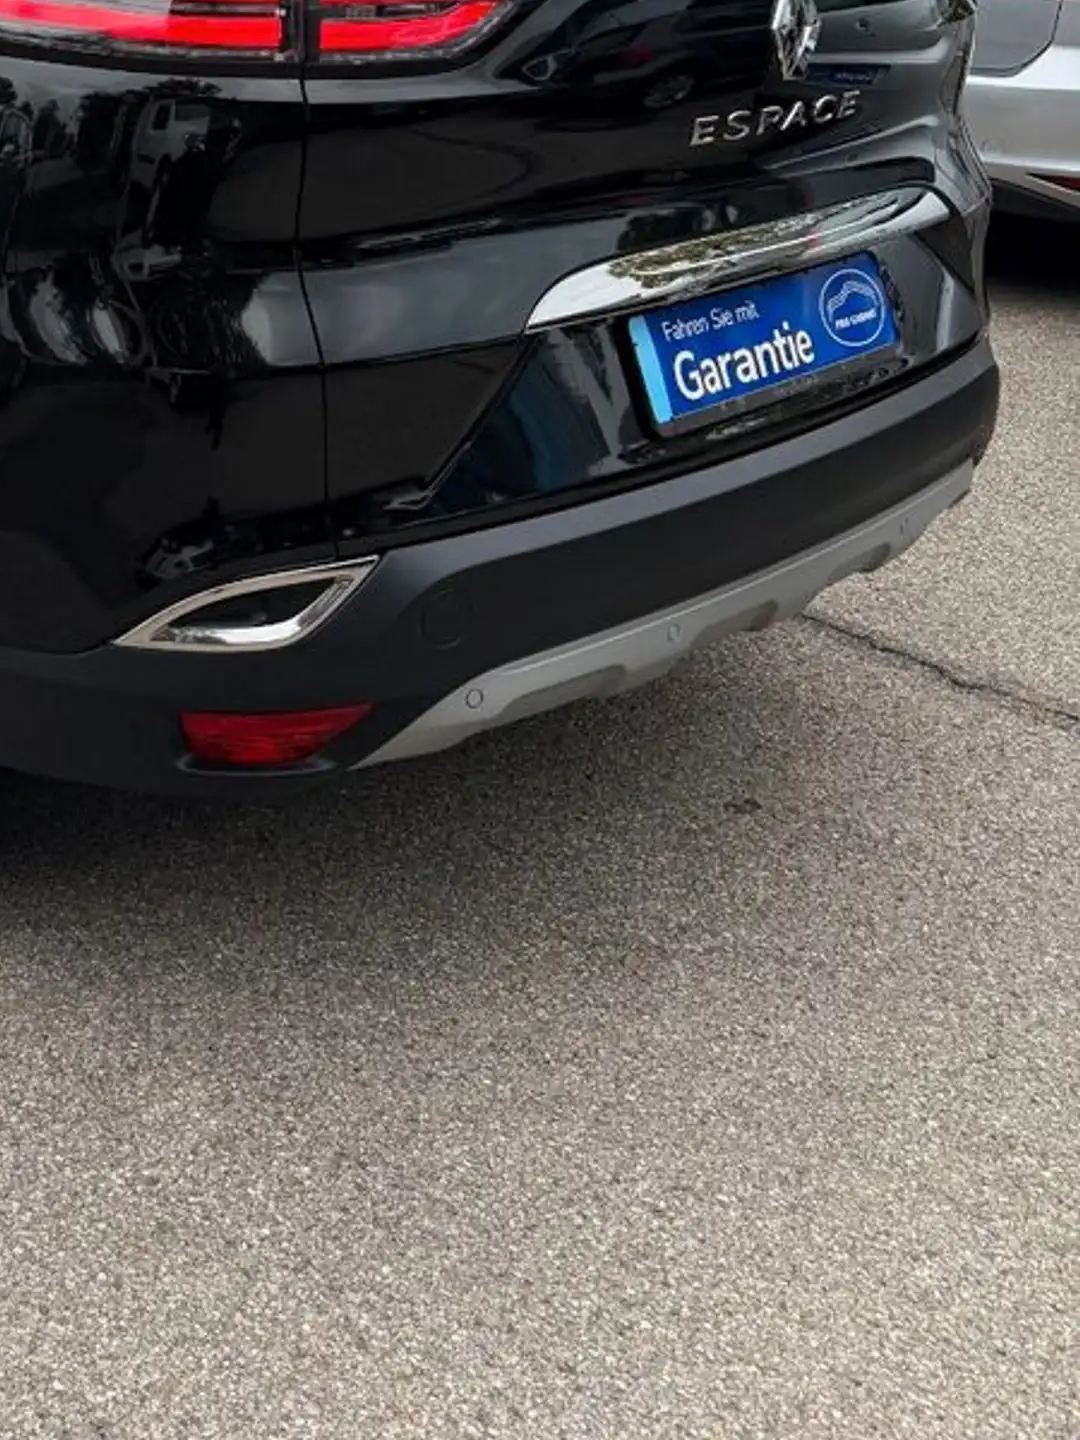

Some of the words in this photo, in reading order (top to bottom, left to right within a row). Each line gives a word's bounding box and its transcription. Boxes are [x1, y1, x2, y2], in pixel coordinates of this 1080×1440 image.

[689, 89, 861, 147] ESPACE
[661, 317, 709, 341] Fahren
[710, 308, 734, 329] Sie
[735, 301, 760, 323] mit
[674, 321, 815, 400] Garantie
